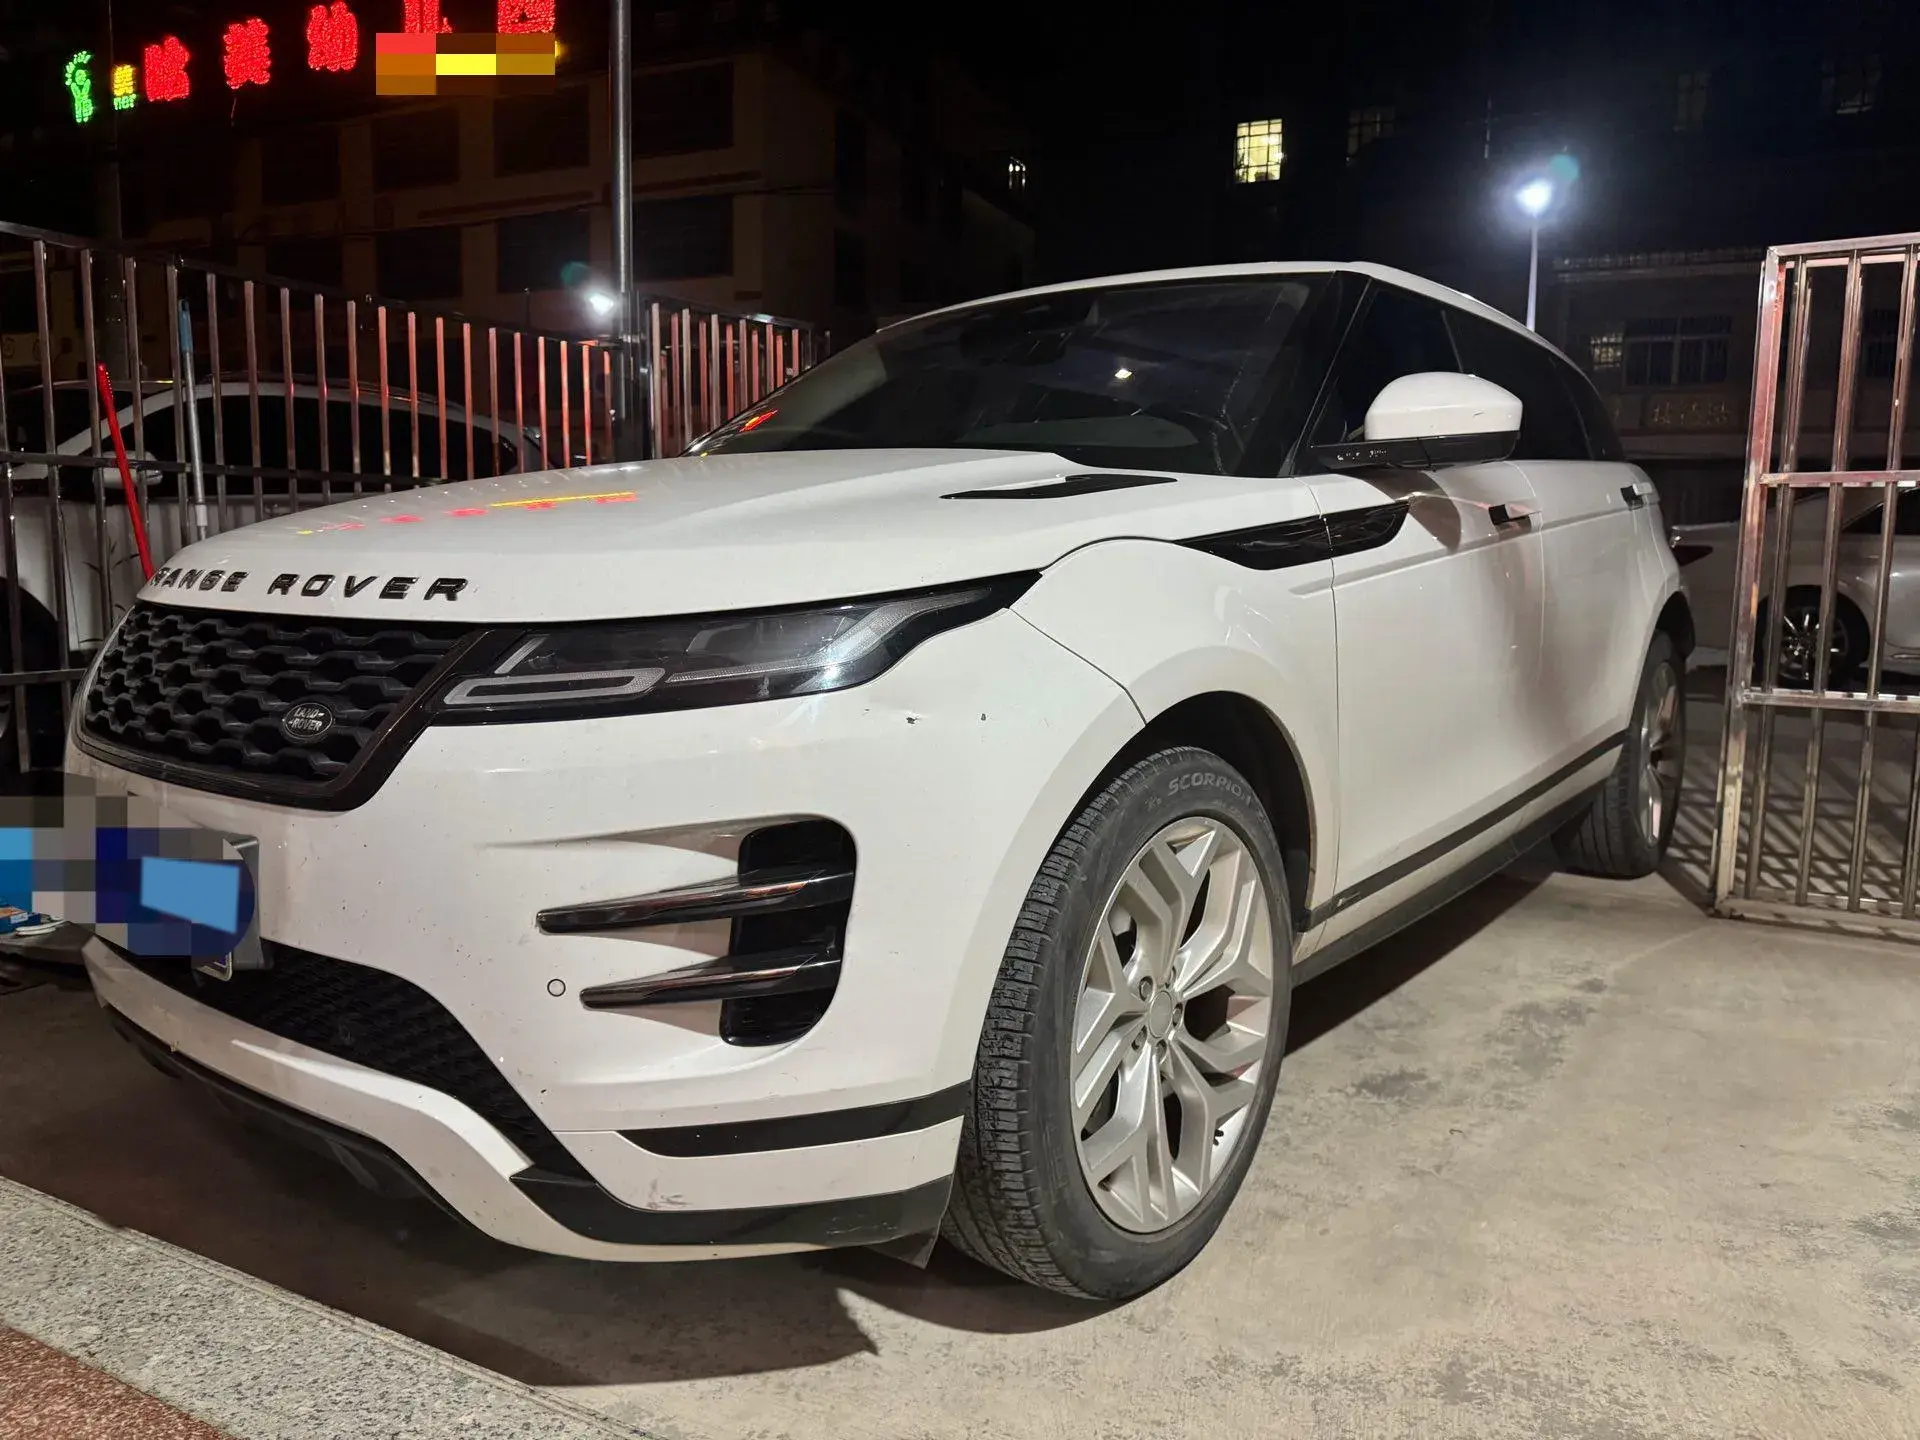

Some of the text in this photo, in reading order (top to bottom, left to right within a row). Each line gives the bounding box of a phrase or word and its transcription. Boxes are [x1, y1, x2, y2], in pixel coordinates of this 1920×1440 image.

[150, 567, 469, 601] RANGE ROVER
[291, 717, 323, 731] ROVER
